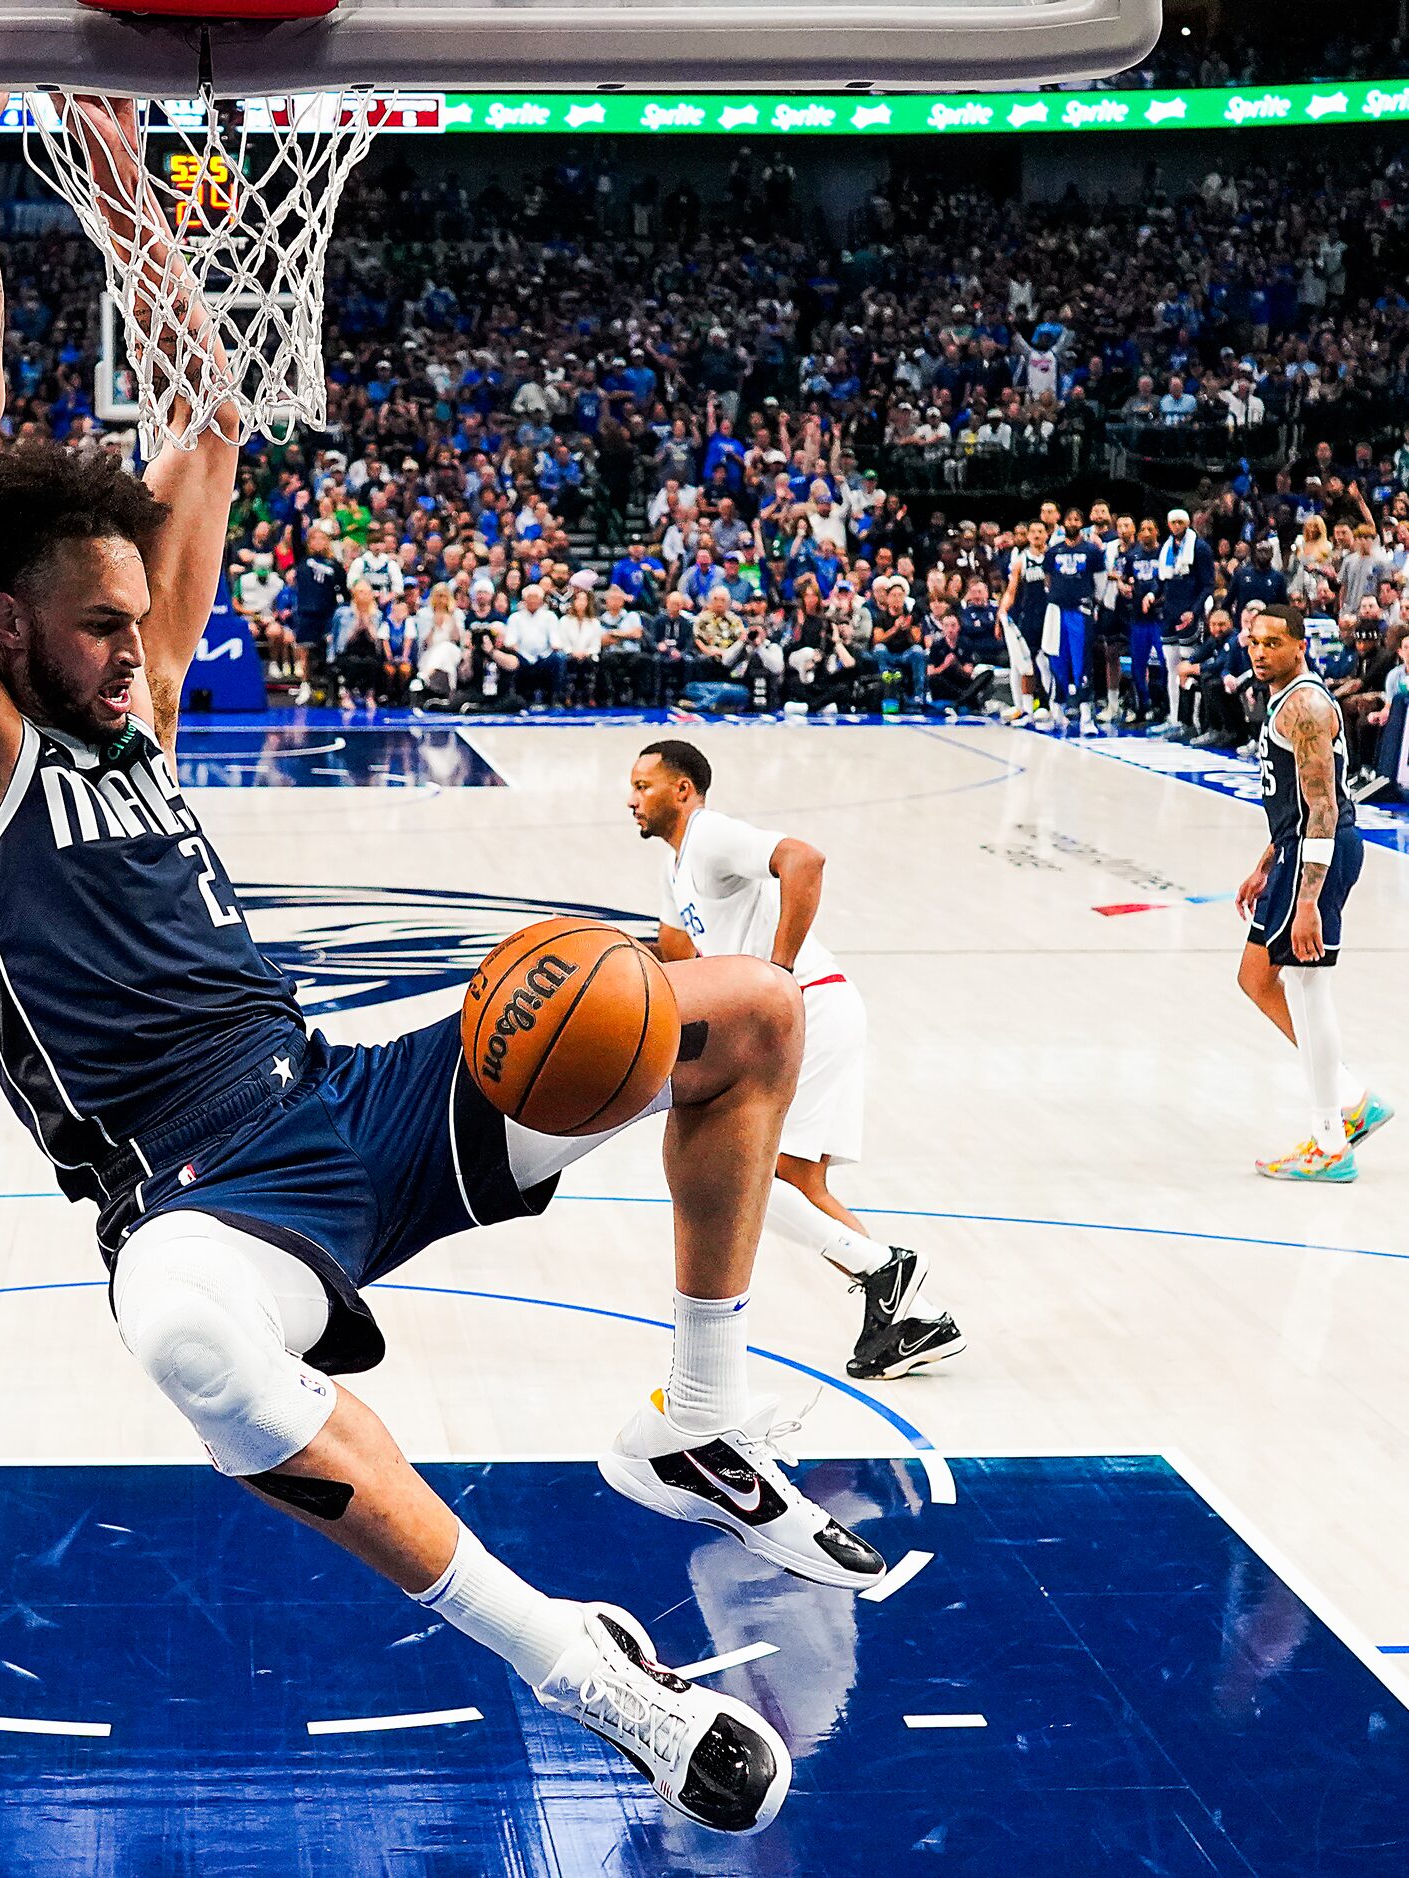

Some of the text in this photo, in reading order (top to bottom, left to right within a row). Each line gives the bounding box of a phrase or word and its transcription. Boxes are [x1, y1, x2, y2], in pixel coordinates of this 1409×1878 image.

[484, 103, 551, 129] Sprite
[640, 103, 706, 130] Sprite
[771, 103, 836, 131] Sprite
[927, 102, 994, 130] Sprite
[1061, 99, 1129, 128] Sprite
[1224, 94, 1291, 124] Sprite
[482, 953, 580, 1083] Wilson
